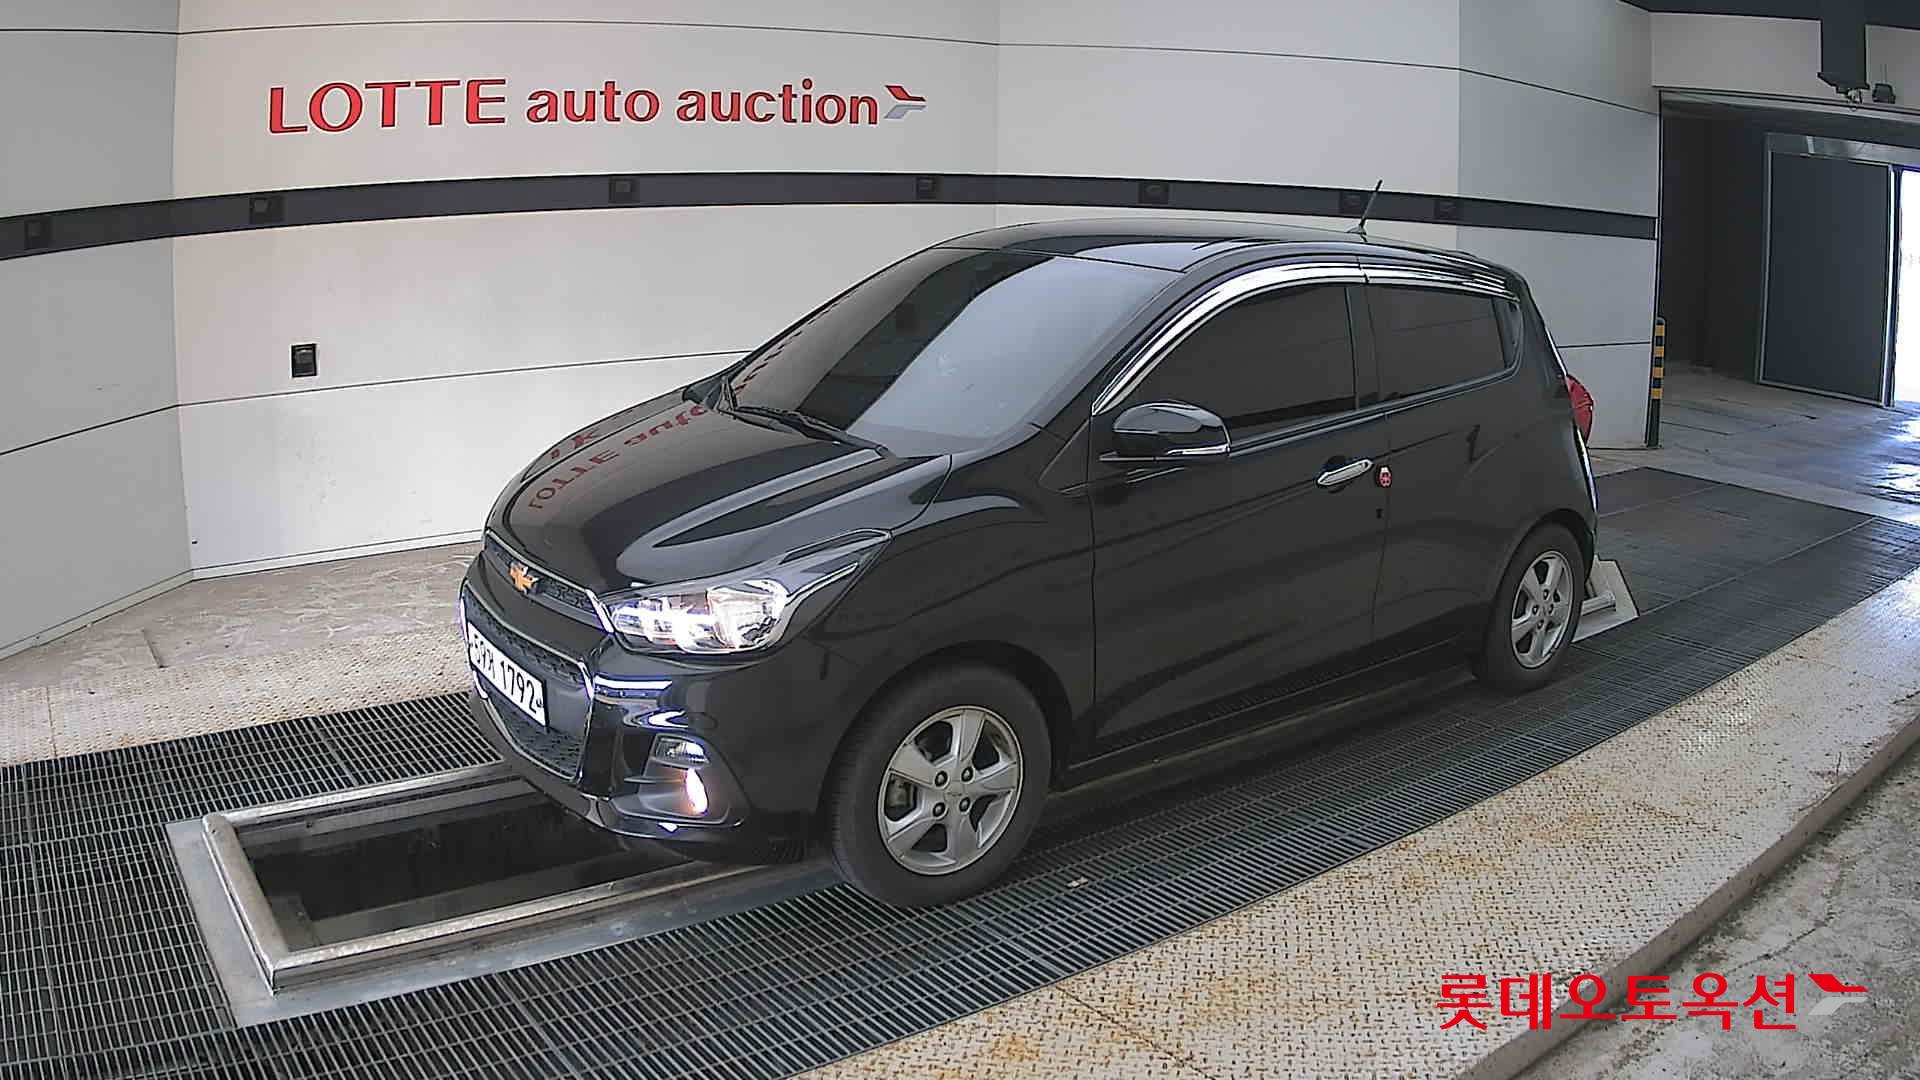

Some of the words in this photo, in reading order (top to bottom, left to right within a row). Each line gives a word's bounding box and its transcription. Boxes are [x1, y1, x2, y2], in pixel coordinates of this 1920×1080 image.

[267, 78, 506, 135] LOTTE
[526, 80, 661, 123] auto
[675, 78, 879, 125] auction
[500, 660, 538, 716] 1792
